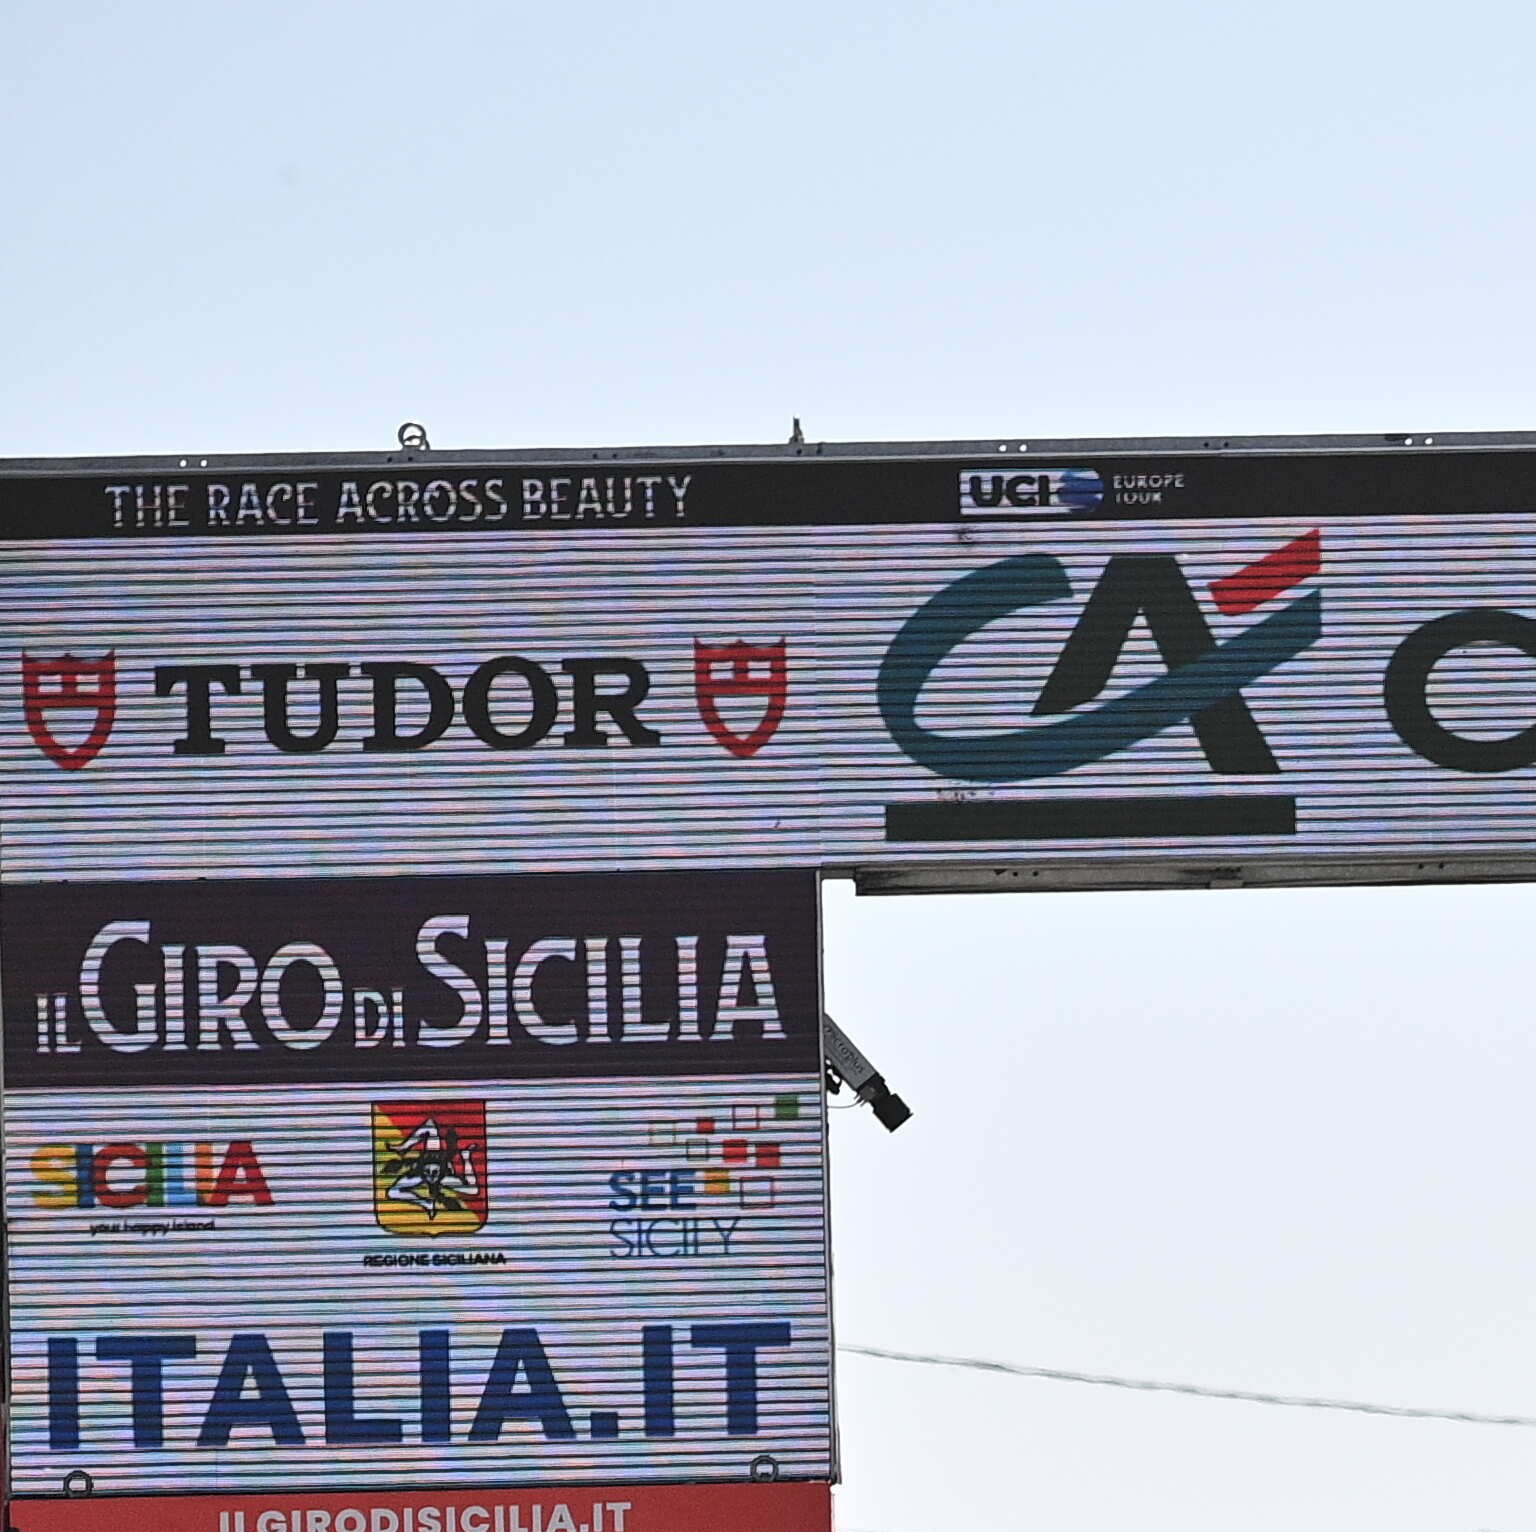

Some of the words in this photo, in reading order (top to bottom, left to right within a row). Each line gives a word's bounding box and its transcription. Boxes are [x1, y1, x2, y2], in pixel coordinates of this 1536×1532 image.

[105, 484, 191, 528] THE
[206, 481, 321, 527] RACE
[335, 478, 509, 525] ACROSS
[521, 475, 694, 522] BEAUTY
[968, 475, 1052, 509] UCI
[153, 654, 662, 756] TUDOR
[414, 914, 788, 1049] SICILIA
[30, 1140, 276, 1210] SICILIA
[607, 1169, 698, 1213] SEE
[362, 1254, 430, 1268] REGIONE
[432, 1251, 508, 1267] SICILIANA
[45, 1321, 794, 1451] ITALIA.IT
